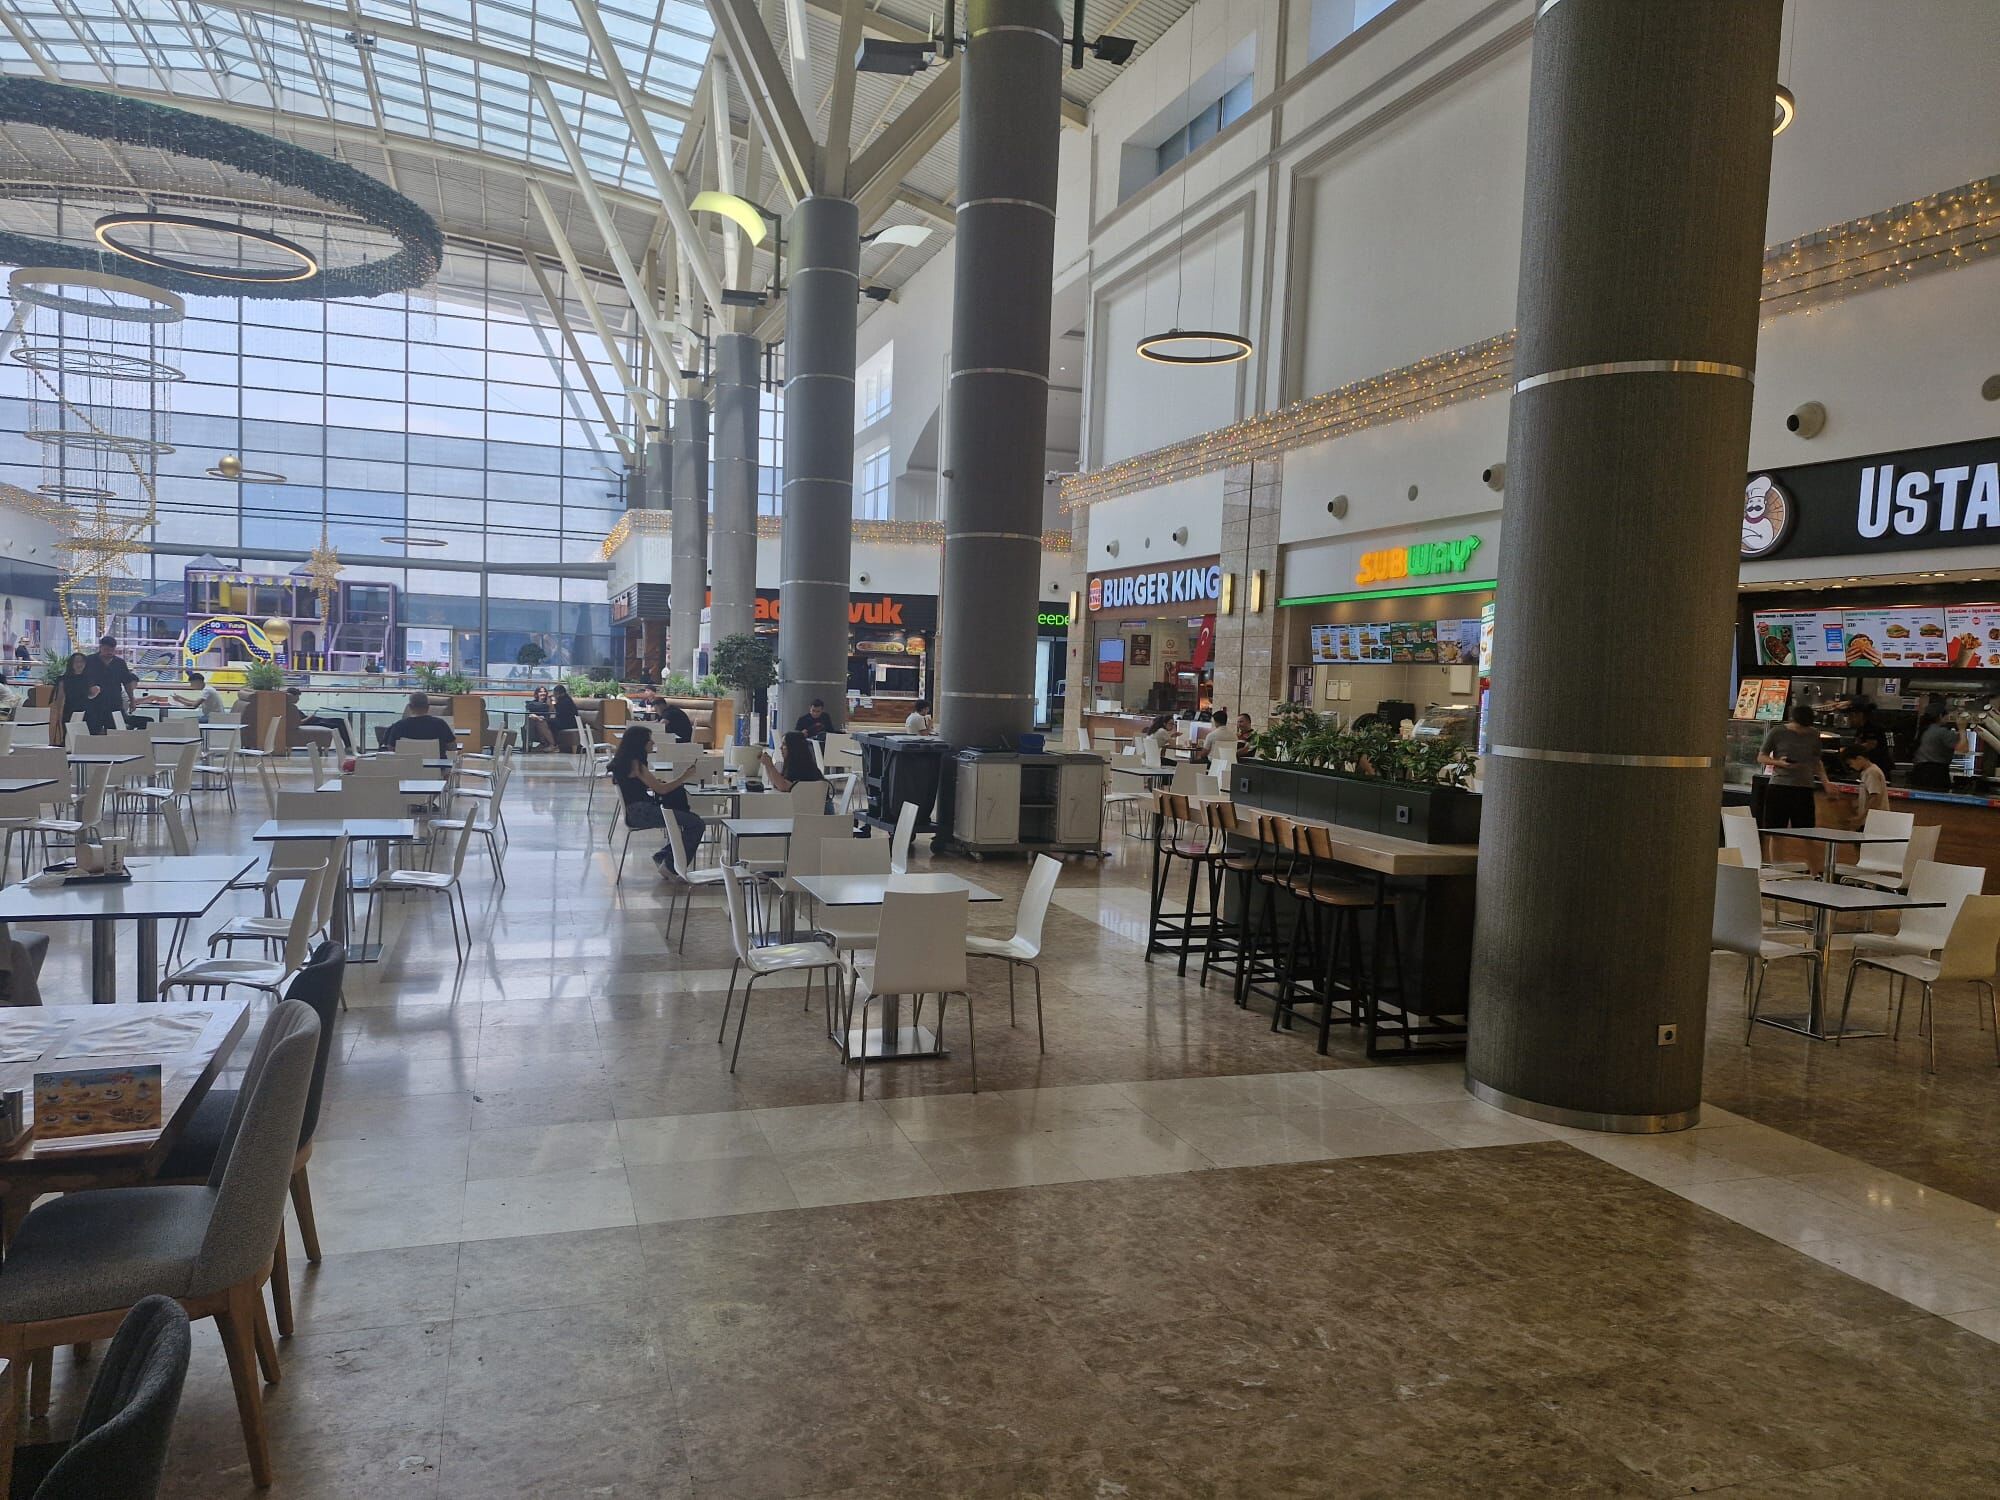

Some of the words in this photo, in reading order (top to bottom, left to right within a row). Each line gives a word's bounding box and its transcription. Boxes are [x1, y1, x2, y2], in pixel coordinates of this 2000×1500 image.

[1857, 462, 2000, 539] USTA
[1356, 534, 1482, 585] SUBWAY
[1103, 572, 1168, 608] BURGER
[1171, 565, 1220, 602] KING
[848, 596, 903, 625] vuk
